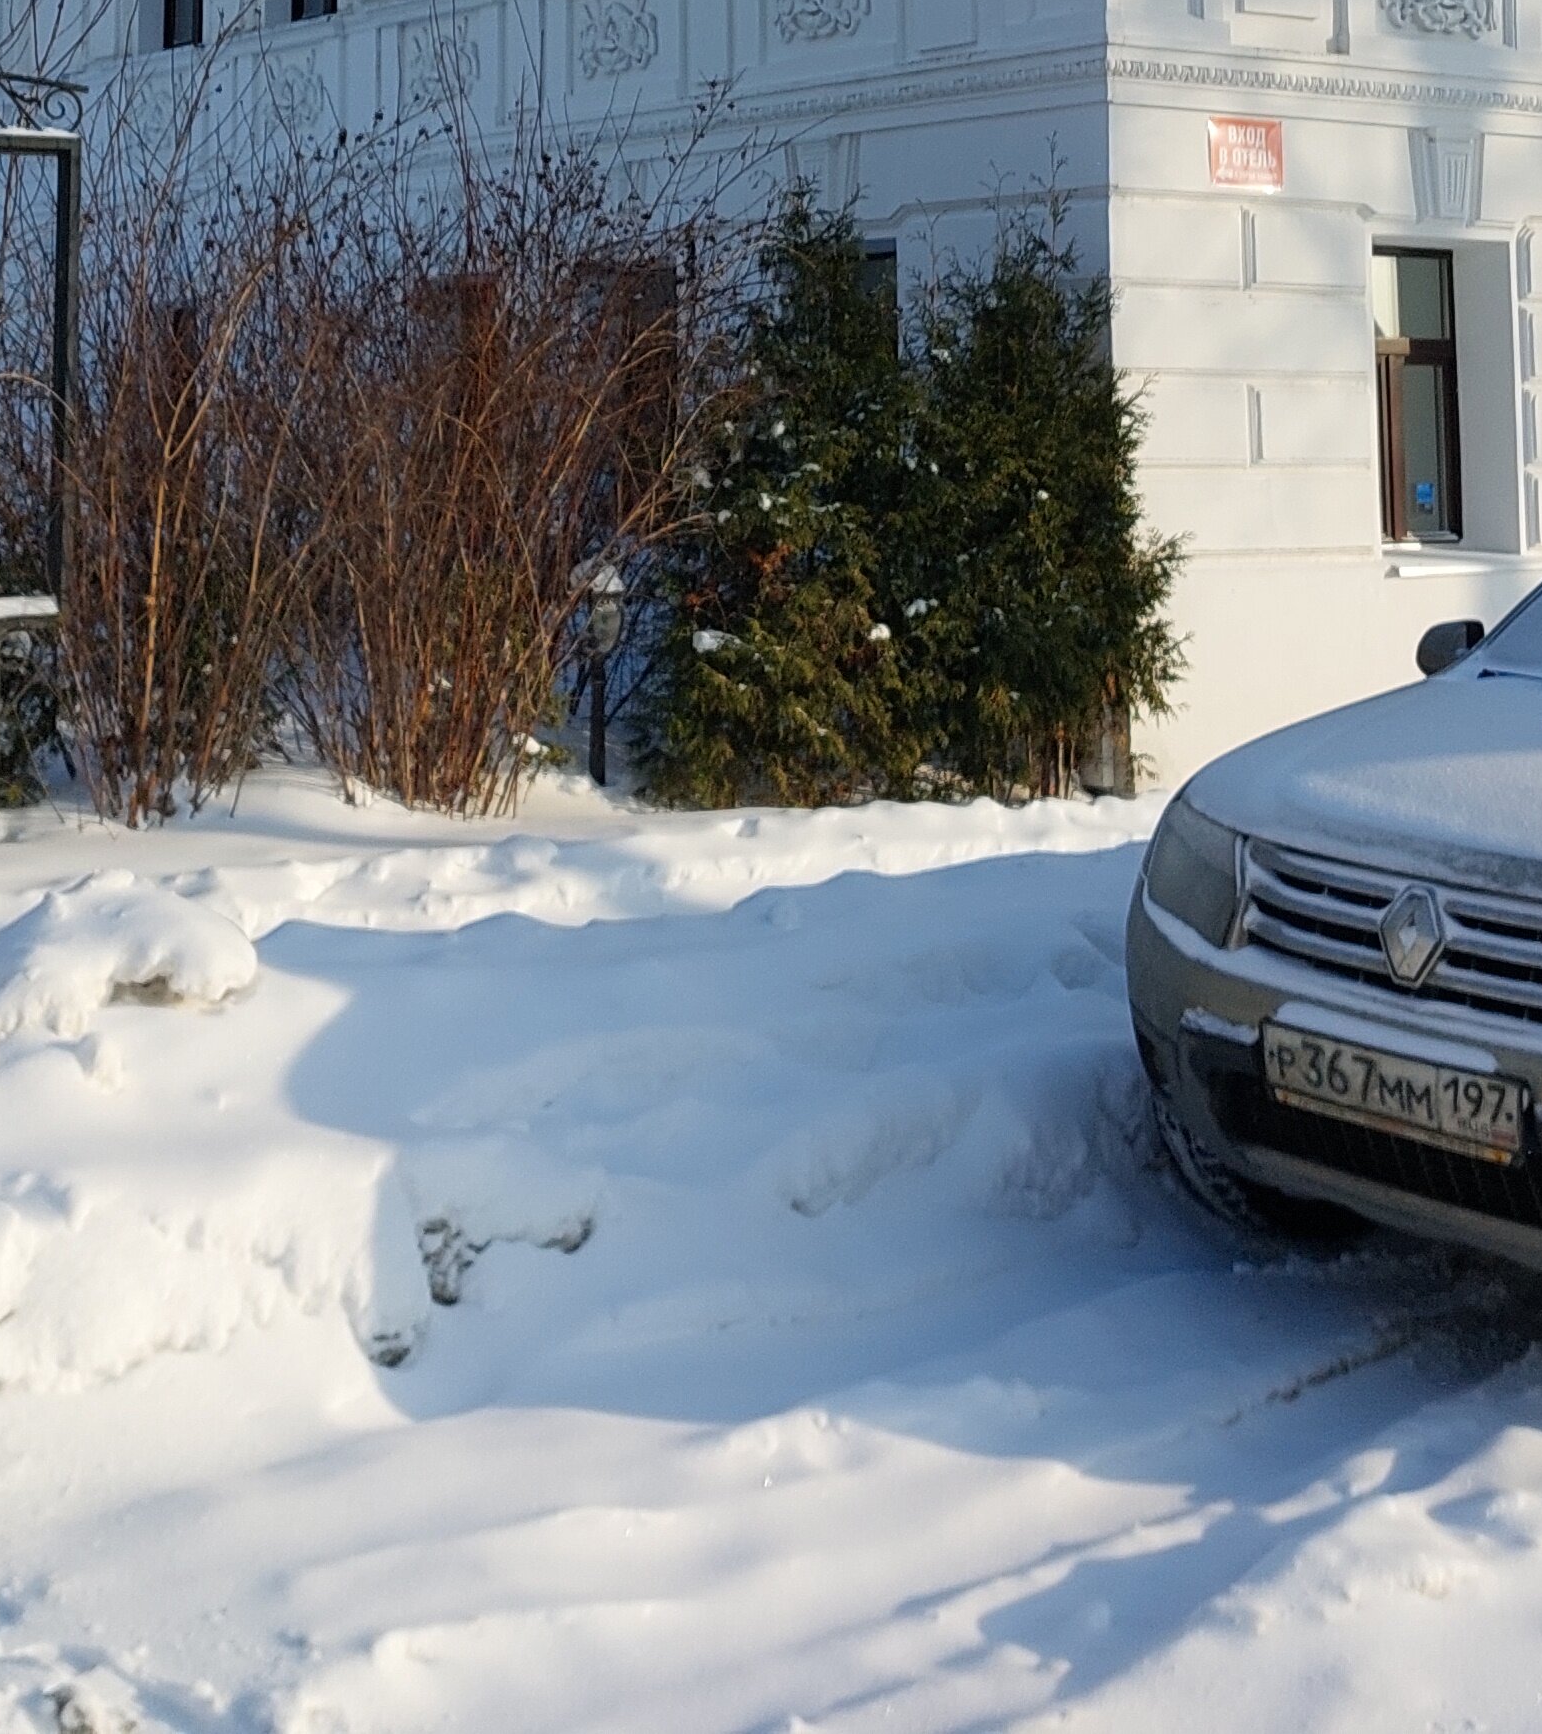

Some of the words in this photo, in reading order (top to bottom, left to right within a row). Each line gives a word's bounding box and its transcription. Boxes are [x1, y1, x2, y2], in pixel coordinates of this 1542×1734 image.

[1228, 124, 1267, 149] ВХОД
[1219, 146, 1228, 166] В
[1232, 147, 1277, 169] ОТЕЛЬ
[1443, 1077, 1506, 1124] 197
